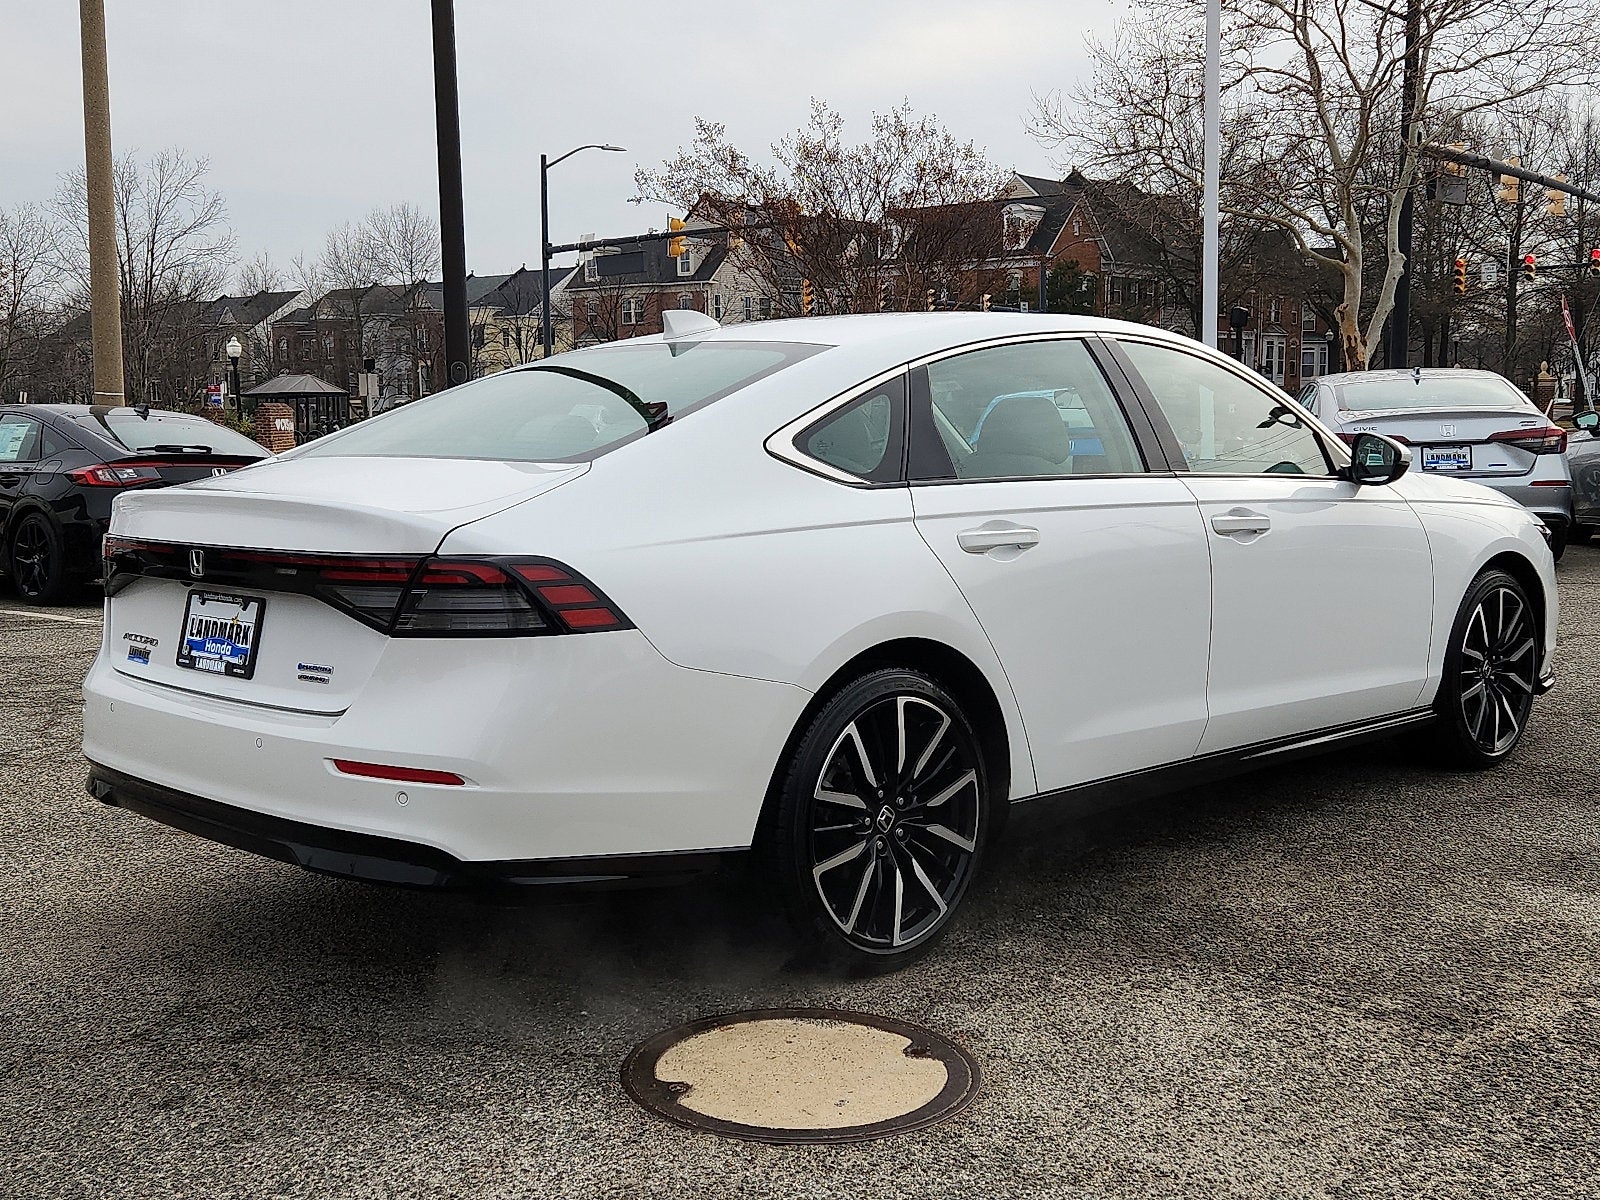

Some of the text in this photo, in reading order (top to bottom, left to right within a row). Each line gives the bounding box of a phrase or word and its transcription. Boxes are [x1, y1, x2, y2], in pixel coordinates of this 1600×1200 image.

[1426, 453, 1468, 461] LANDMARK
[188, 617, 251, 646] LANDMARK
[204, 639, 232, 656] Honda
[195, 658, 226, 673] LANDMARK
